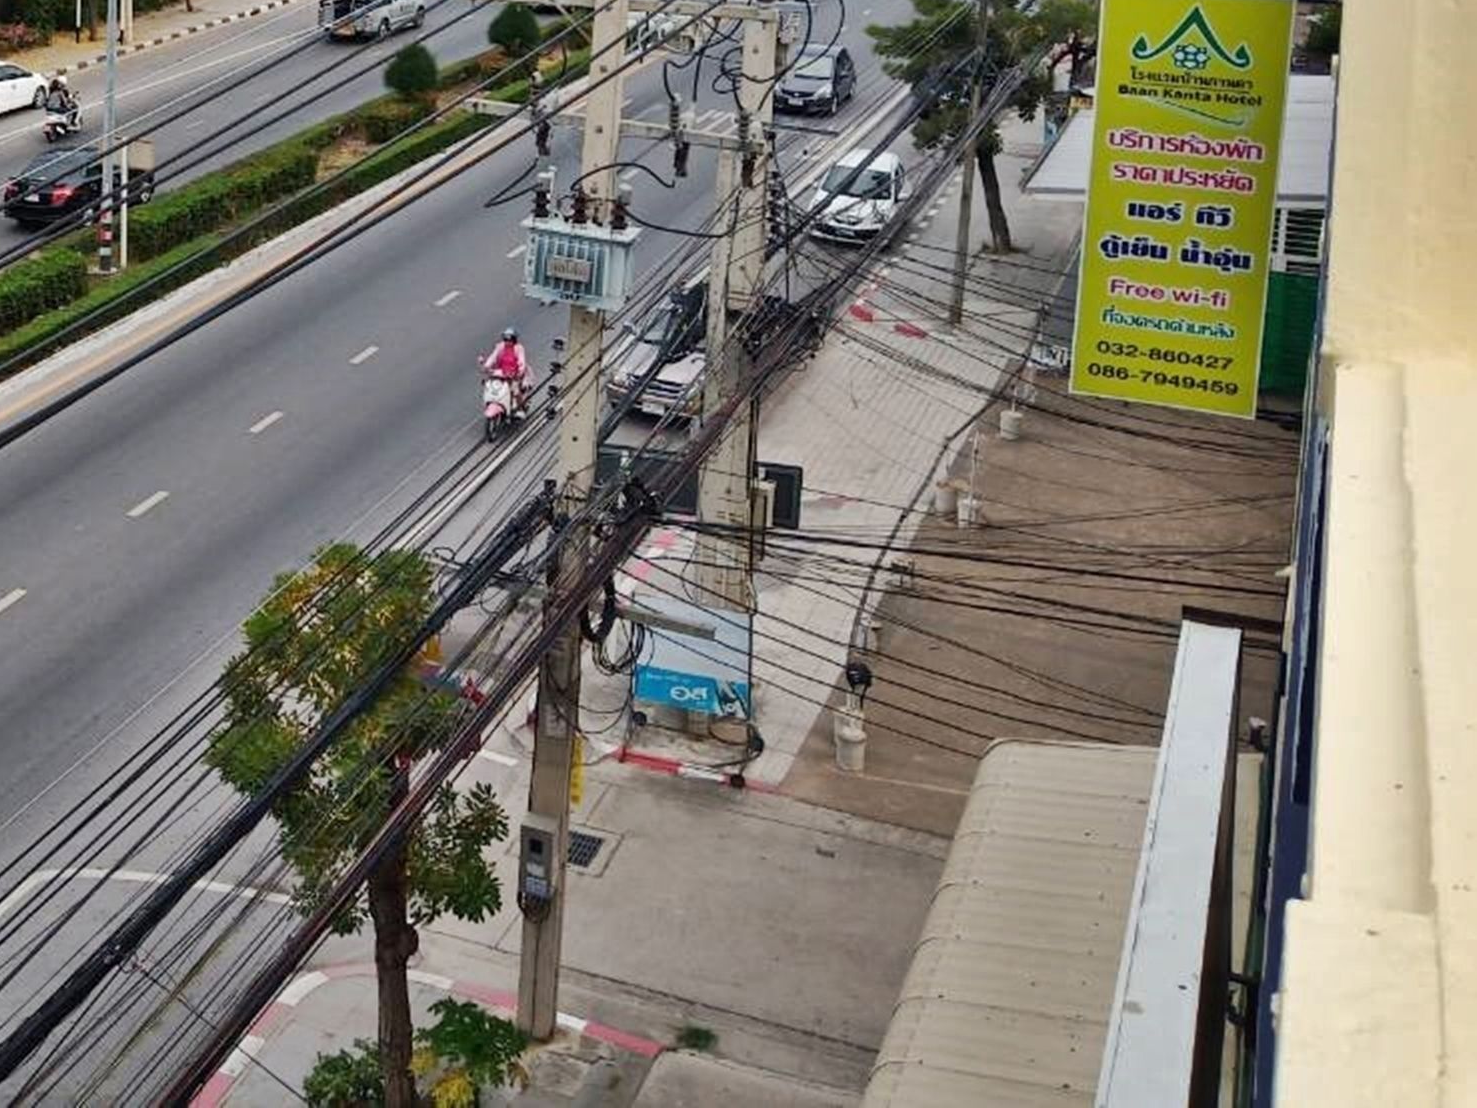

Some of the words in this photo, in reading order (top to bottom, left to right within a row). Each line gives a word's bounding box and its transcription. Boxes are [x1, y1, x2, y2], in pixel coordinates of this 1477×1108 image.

[1118, 84, 1159, 97] Baan
[1163, 88, 1212, 102] Kanta
[1216, 93, 1263, 107] Hotel
[1108, 129, 1264, 161] บริการห้องพัก
[1113, 164, 1254, 192] ราคาประหยัด
[1127, 202, 1183, 222] แอร์
[1195, 205, 1232, 228] ทีวี
[1100, 235, 1168, 260] ตู้เย็น
[1180, 239, 1252, 272] น้ำอุ่น
[1110, 279, 1165, 300] Free
[1171, 289, 1227, 307] wi-fi
[1101, 304, 1235, 339] ที่จอดรถด้านหลัง
[1097, 340, 1234, 371] 032-860427
[1087, 362, 1239, 396] 086-7949459
